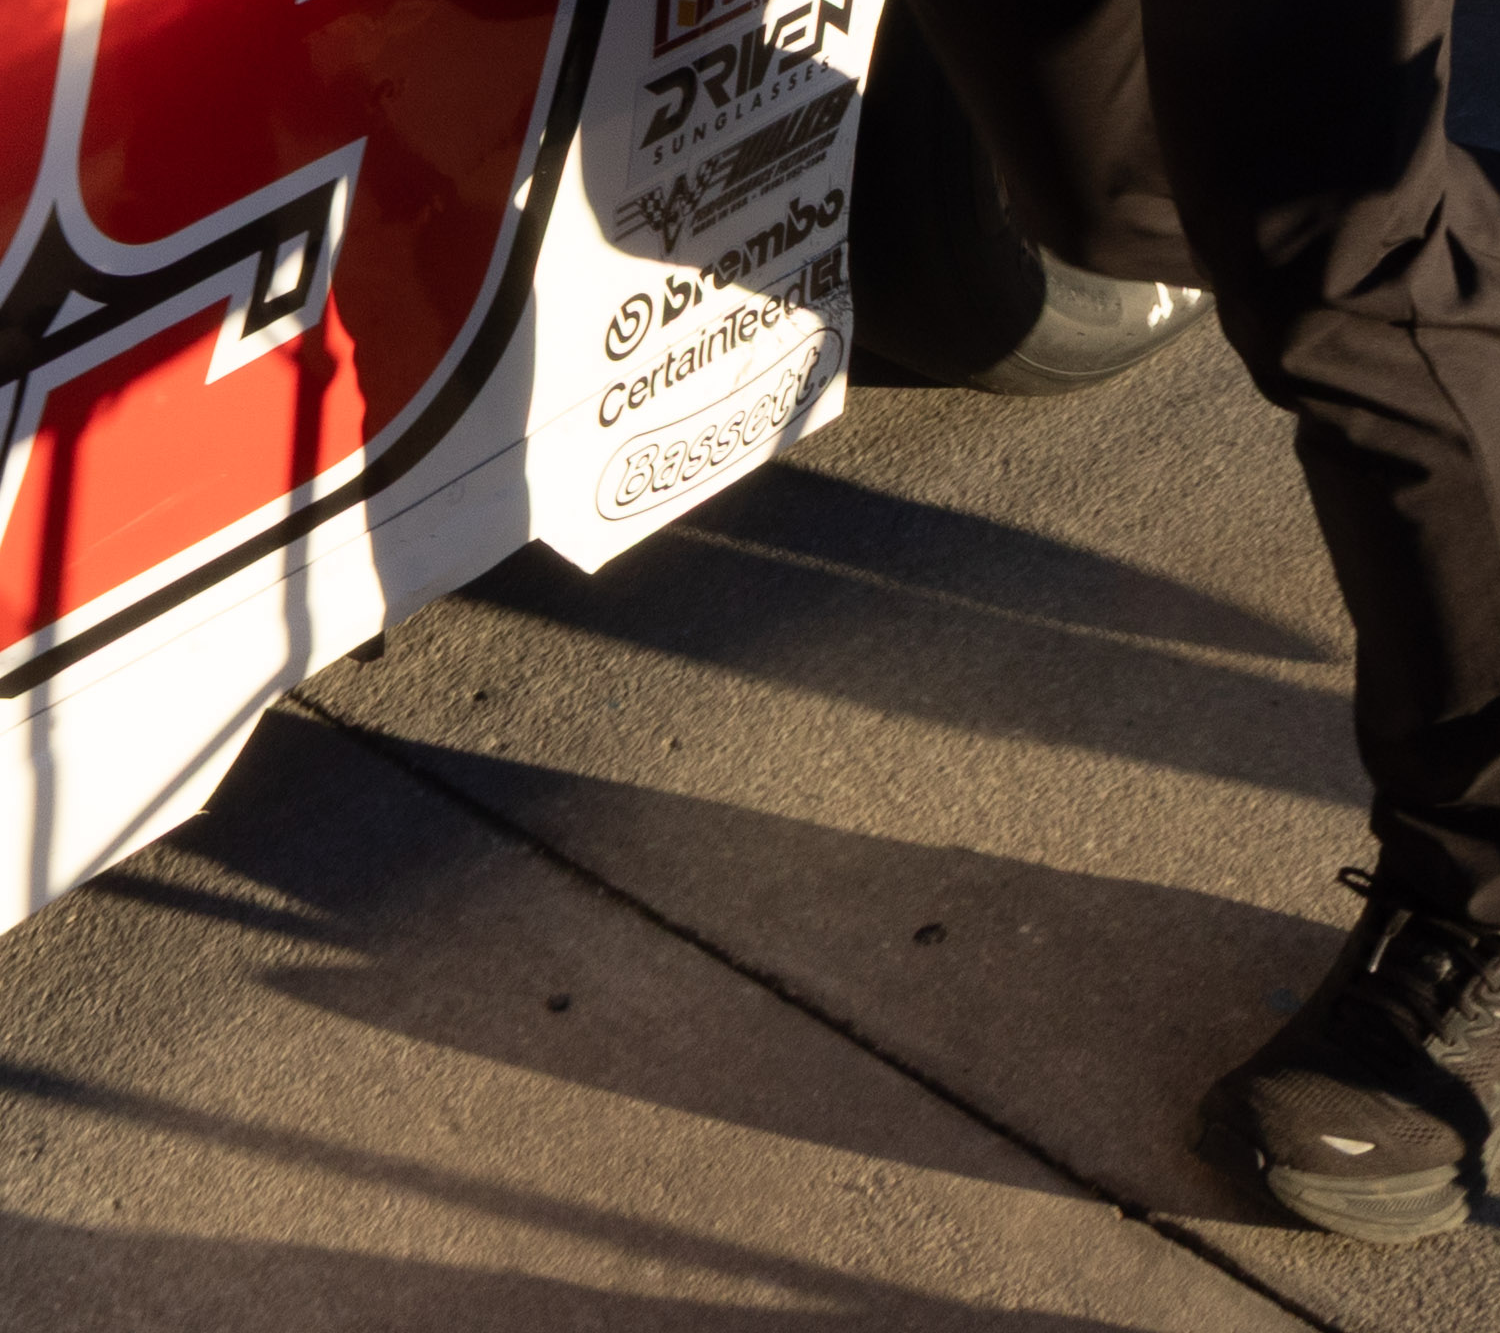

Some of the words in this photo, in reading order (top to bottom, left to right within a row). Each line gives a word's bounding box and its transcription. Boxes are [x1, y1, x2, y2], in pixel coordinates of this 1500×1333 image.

[653, 55, 830, 165] SUNGLASSES
[661, 188, 844, 328] brembo
[599, 268, 809, 427] CertainTeed
